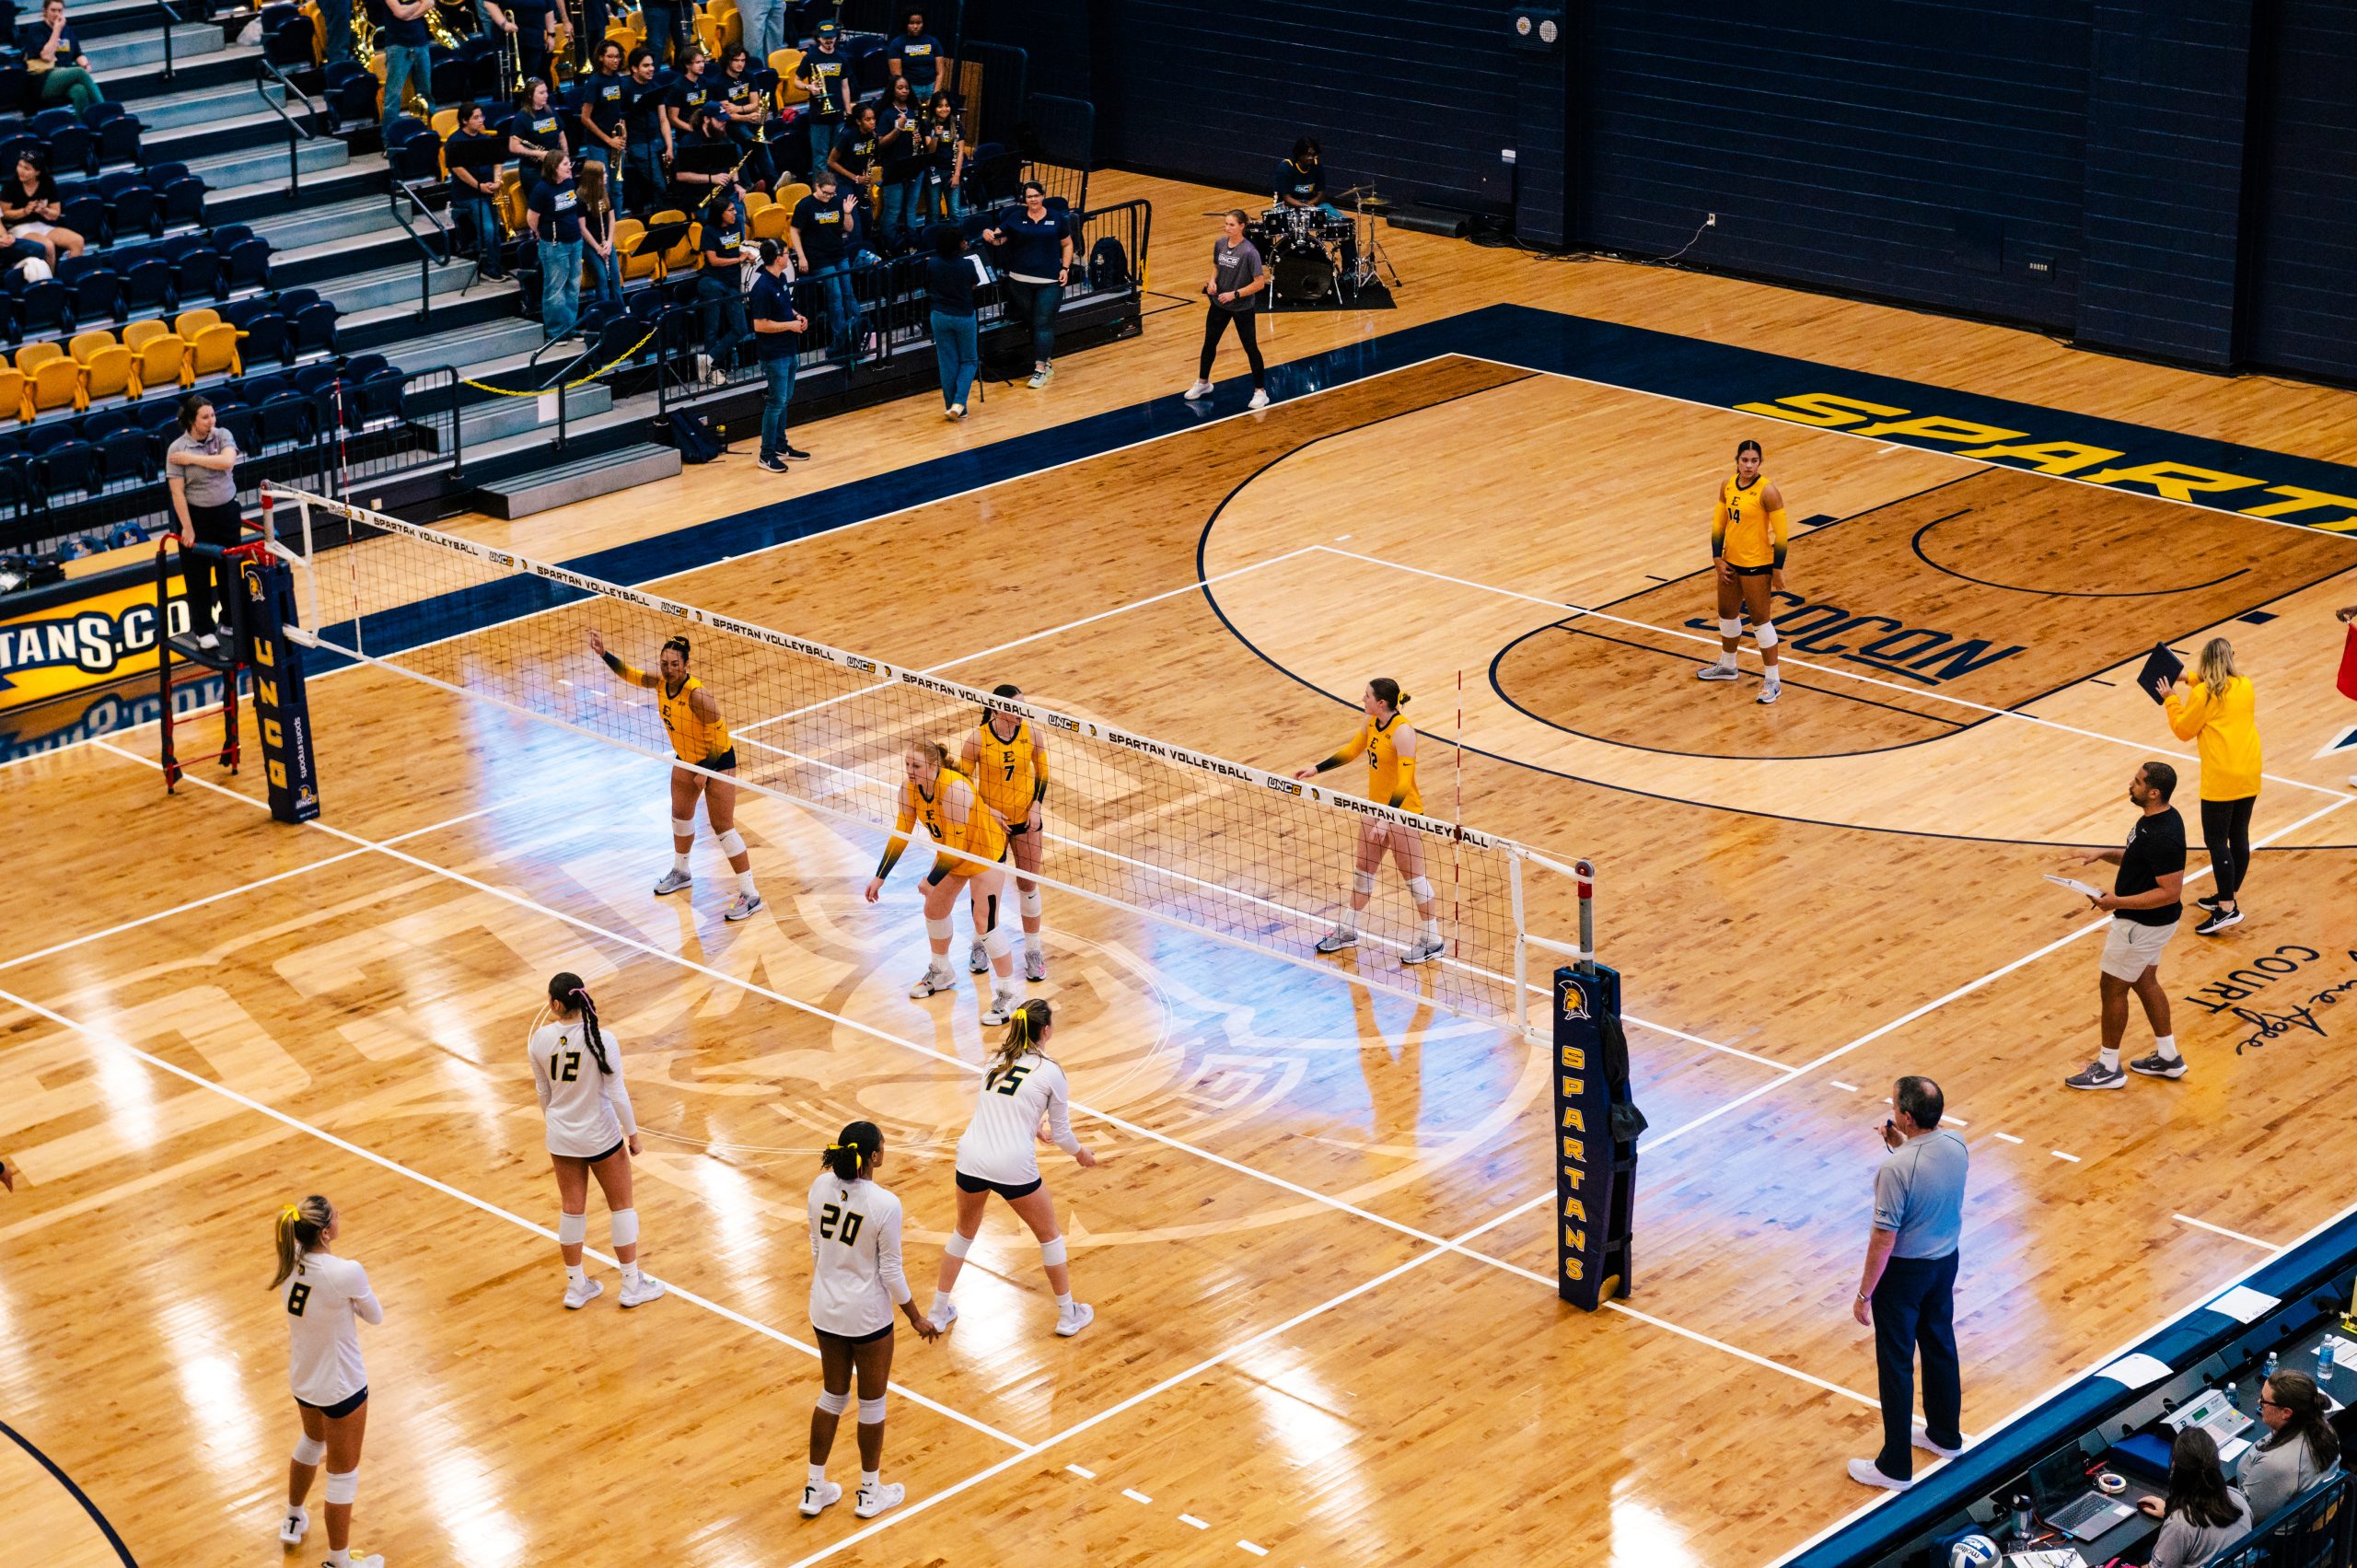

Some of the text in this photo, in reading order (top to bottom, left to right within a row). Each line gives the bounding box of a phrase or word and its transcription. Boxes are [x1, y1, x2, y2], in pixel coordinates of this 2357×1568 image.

[1218, 253, 1239, 265] UNCG
[1733, 392, 2357, 532] SPART
[1727, 507, 1740, 524] 14
[374, 517, 416, 539] SPARTAN
[419, 531, 479, 556] VOLLEYBALL
[489, 551, 515, 567] UNCG
[536, 565, 582, 586] SPARTAN
[585, 582, 650, 607] VOLLEYBALL
[660, 601, 689, 619] UNCG
[712, 618, 761, 640] SPARTAN
[763, 633, 835, 661] VOLLEYBALL
[846, 656, 876, 674] UNCG
[902, 672, 956, 696] SPARTAN
[958, 689, 1036, 719] VOLLEYBALL
[1048, 714, 1080, 733] UNCG
[1109, 732, 1166, 758] SPARTAN
[1169, 749, 1253, 782] VOLLEYBALL
[1267, 776, 1302, 796] UNCG
[1333, 796, 1396, 824] SPARTAN
[1399, 814, 1489, 849] VOLLEYALL
[254, 636, 287, 790] UNCG
[294, 716, 308, 779] sports imports
[1003, 750, 1016, 763] E
[1367, 749, 1378, 771] 12
[1370, 738, 1378, 749] E
[1004, 764, 1016, 782] 7
[2184, 946, 2320, 1014] COURT
[550, 1052, 581, 1083] 12
[986, 1064, 1031, 1097] 15
[1561, 1045, 1587, 1282] SPARTANS
[819, 1202, 865, 1247] 20
[286, 1281, 311, 1317] 8
